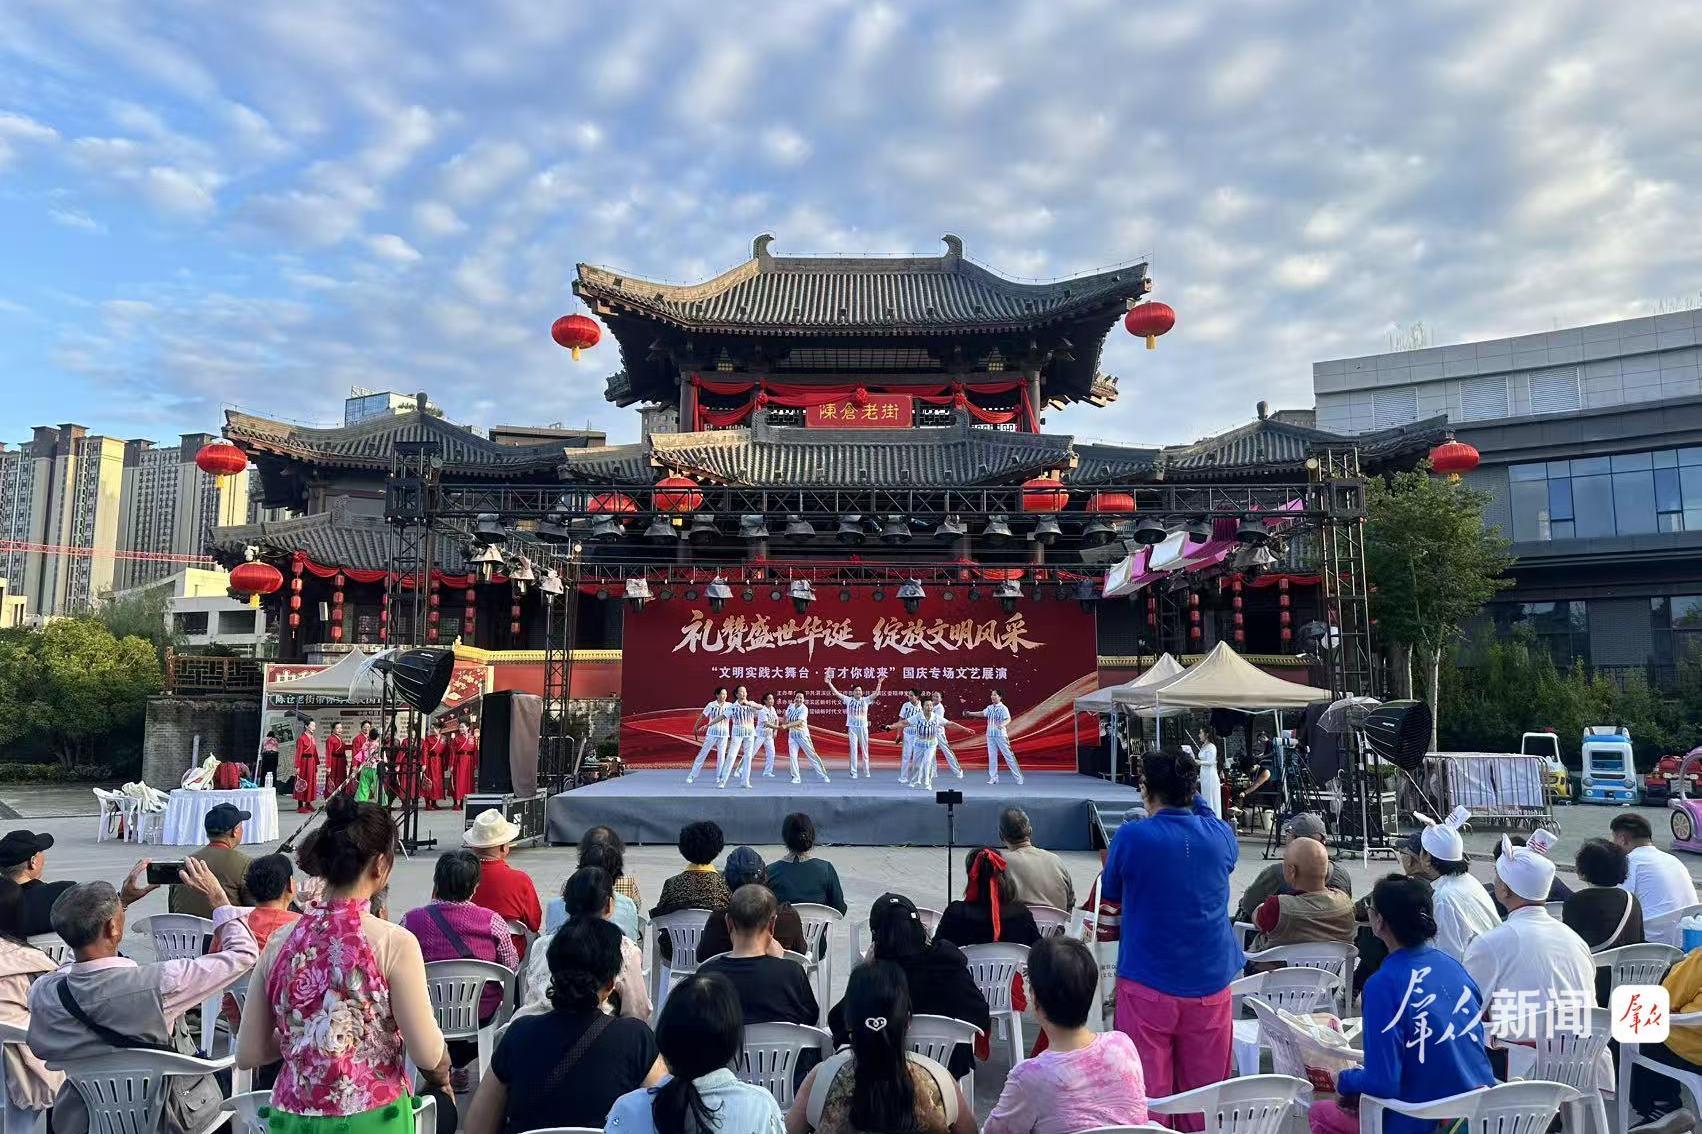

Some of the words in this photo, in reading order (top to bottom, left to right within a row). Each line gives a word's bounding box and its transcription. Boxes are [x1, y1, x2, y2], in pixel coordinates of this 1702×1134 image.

[819, 402, 899, 420] 陳倉老街
[671, 609, 868, 663] 礼赞盛世华诞
[872, 612, 1048, 655] 绽放文明风采
[902, 666, 1008, 680] 国庆专场文艺展演
